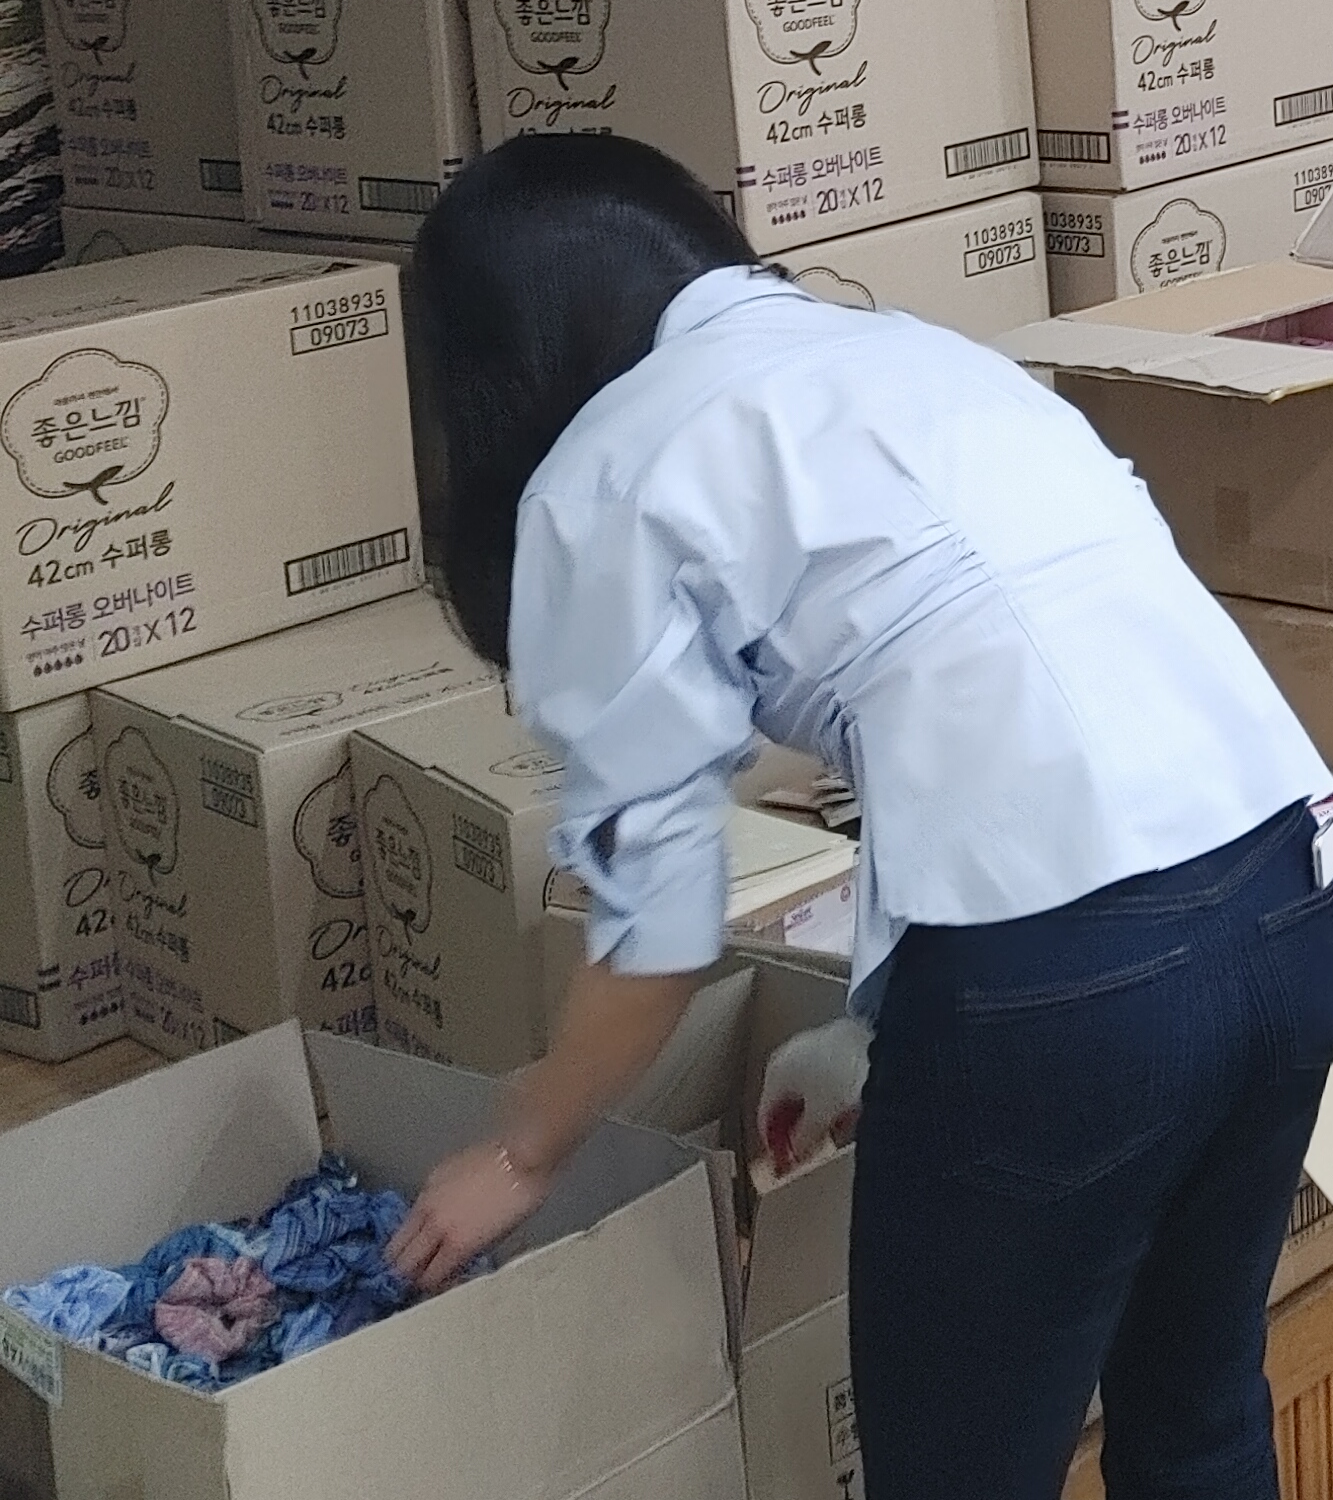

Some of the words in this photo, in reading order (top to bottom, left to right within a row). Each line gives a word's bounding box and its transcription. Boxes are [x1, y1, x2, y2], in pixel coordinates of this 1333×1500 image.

[782, 15, 835, 33] GOODFEEL
[1130, 18, 1218, 67] Original
[260, 75, 347, 113] Original
[756, 60, 869, 117] Original
[1137, 70, 1173, 92] 42cm
[1176, 58, 1215, 84] 수퍼롱
[507, 82, 617, 127] Original
[1132, 107, 1169, 134] 수퍼롱
[1171, 95, 1227, 127] 오버나이트
[766, 120, 813, 145] 42cm
[816, 106, 868, 136] 수퍼롱
[761, 164, 807, 193] 수퍼롱
[811, 144, 884, 183] 오버나이트
[1304, 186, 1332, 205] 0907
[963, 217, 1033, 249] 11038935
[1047, 234, 1091, 253] 09073
[978, 244, 1022, 270] 09073
[1148, 239, 1213, 275] 좋은느낌
[290, 289, 386, 324] 11038935
[310, 319, 370, 347] 09073
[31, 398, 141, 449] 좋은느낌
[54, 436, 129, 464] GOODFEEL
[15, 480, 176, 557] Original
[27, 559, 95, 588] 42cm
[101, 528, 174, 568] 수퍼롱
[20, 602, 87, 641] 수퍼롱
[92, 573, 196, 621] 오버나이트
